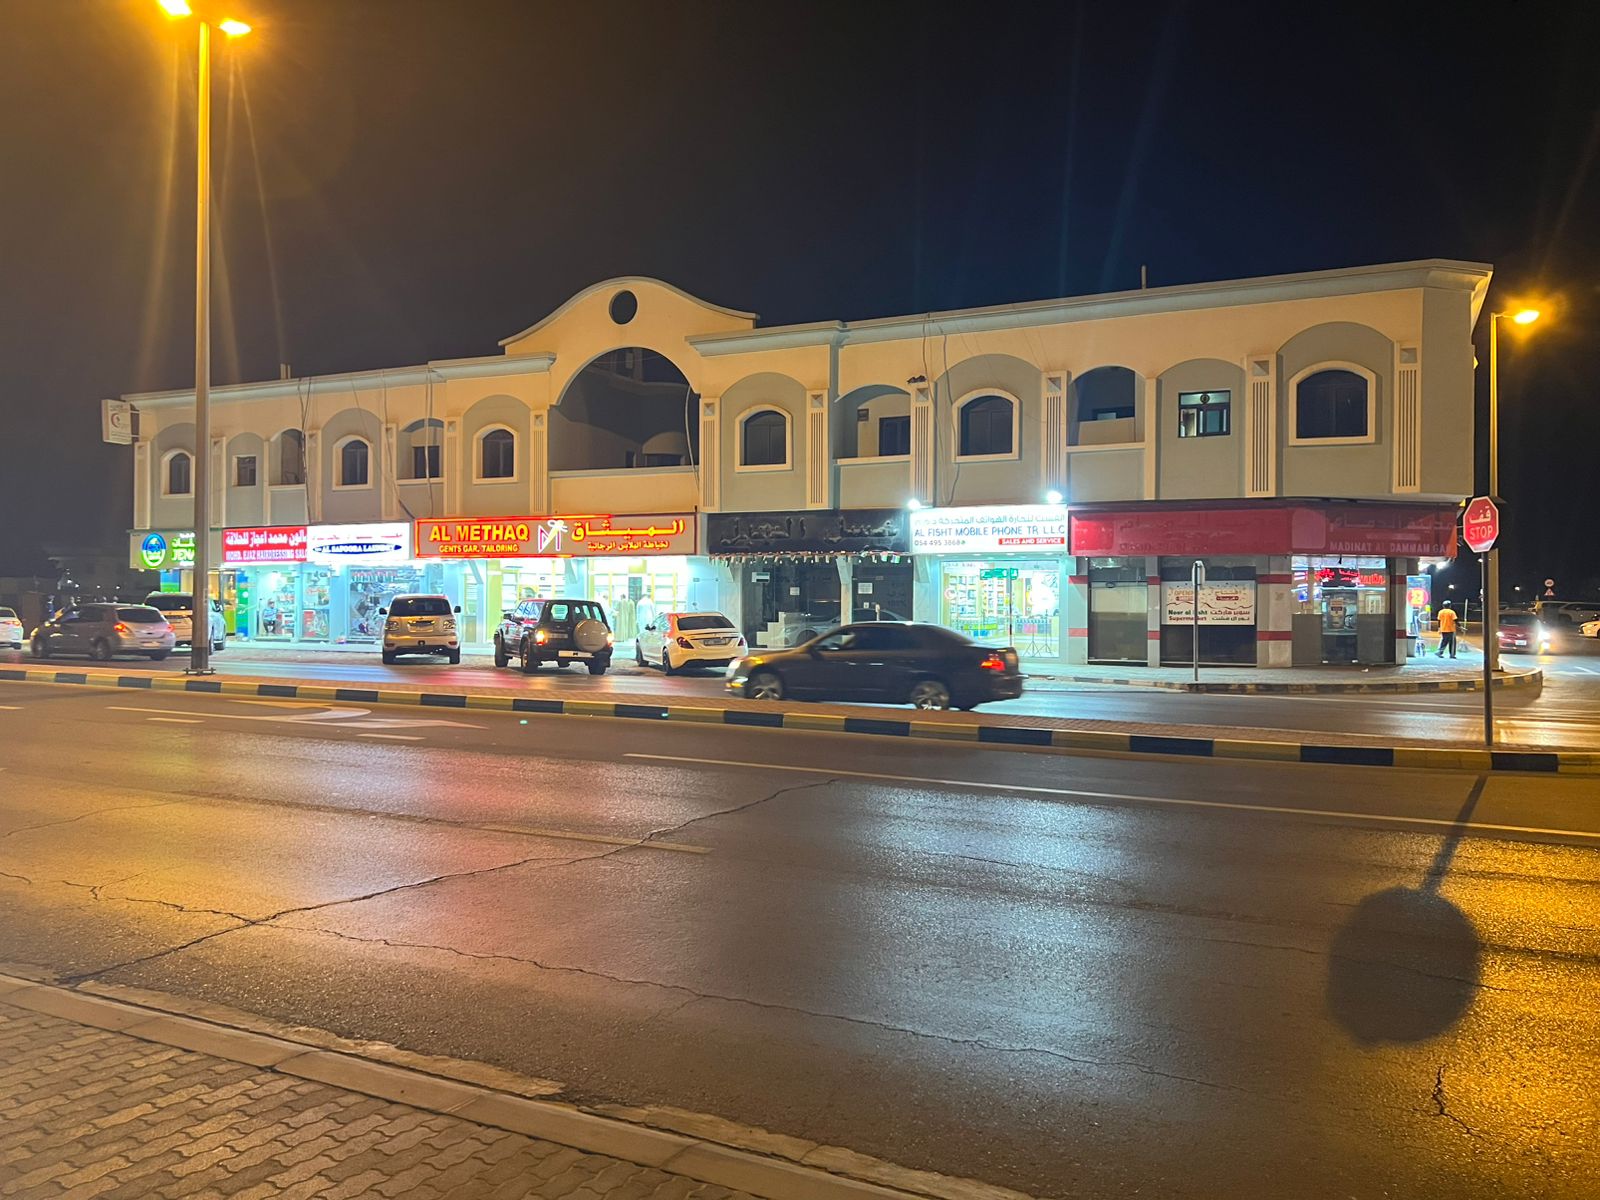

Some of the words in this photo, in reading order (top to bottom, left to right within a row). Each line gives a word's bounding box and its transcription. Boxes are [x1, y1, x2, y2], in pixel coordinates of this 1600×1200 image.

[1470, 506, 1491, 524] قف
[429, 525, 451, 541] AL
[456, 524, 529, 541] METHAQ
[571, 520, 685, 541] الميثاق
[914, 529, 924, 537] AL
[928, 528, 952, 537] FISHT
[956, 527, 989, 536] MOBILE
[992, 526, 1022, 535] PHONE
[1470, 525, 1493, 540] STOP
[439, 545, 462, 553] GENTS
[463, 544, 480, 553] GAR.
[482, 543, 518, 552] TAILORING
[1330, 541, 1371, 552] MADINAT
[1391, 543, 1430, 553] DAMMAM
